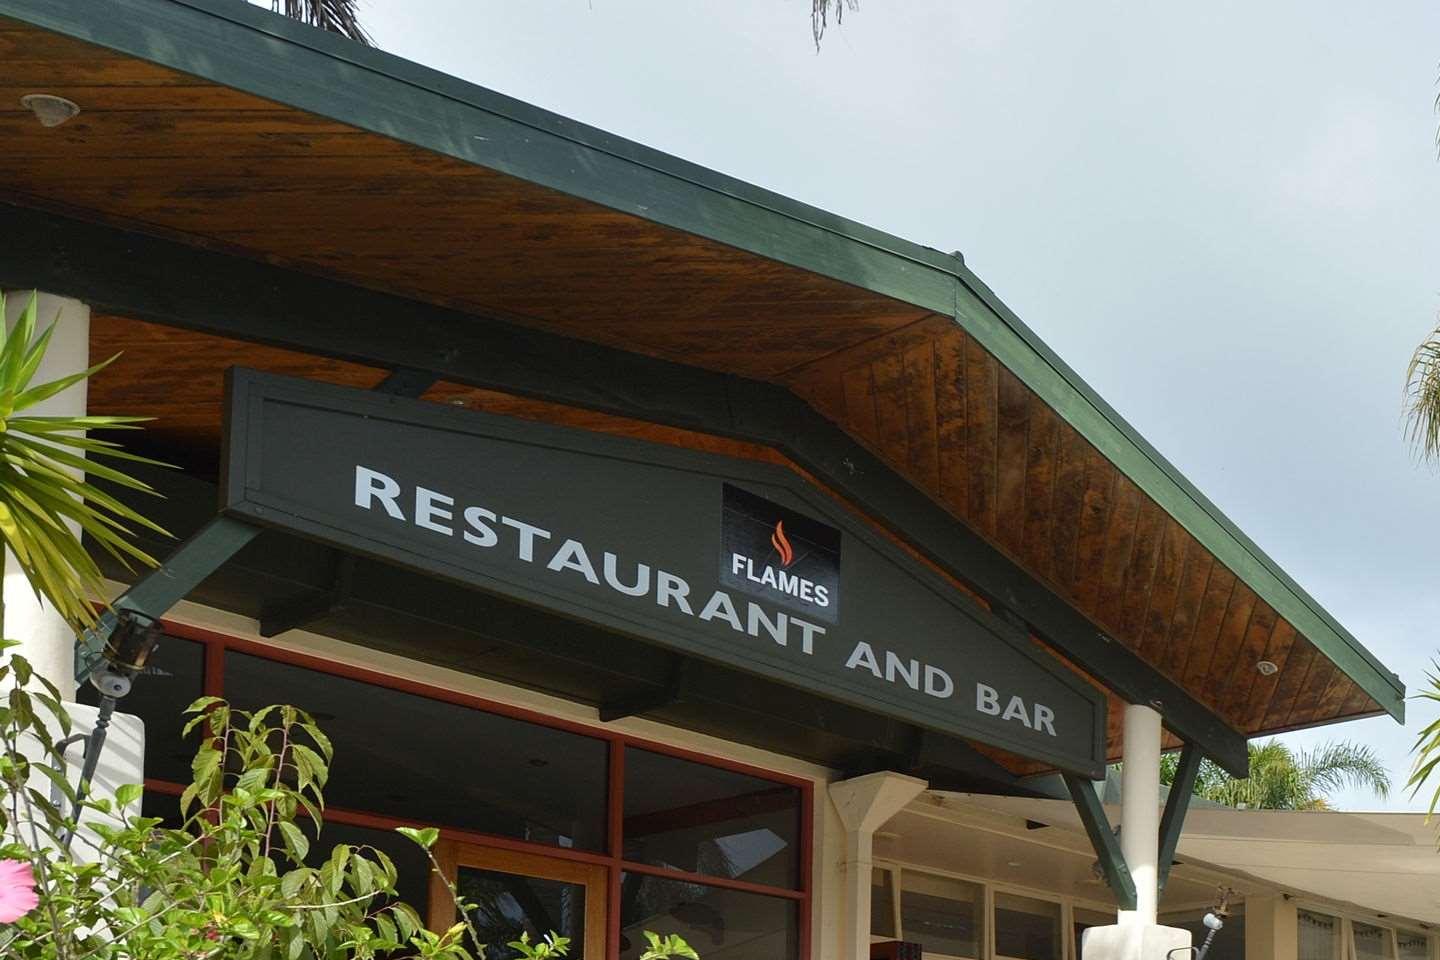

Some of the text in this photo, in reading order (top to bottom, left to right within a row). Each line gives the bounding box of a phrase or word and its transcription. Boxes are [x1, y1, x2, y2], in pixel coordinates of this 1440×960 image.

[354, 466, 1058, 736] RESTAURANT AND BAR
[732, 552, 830, 608] FLAMES
